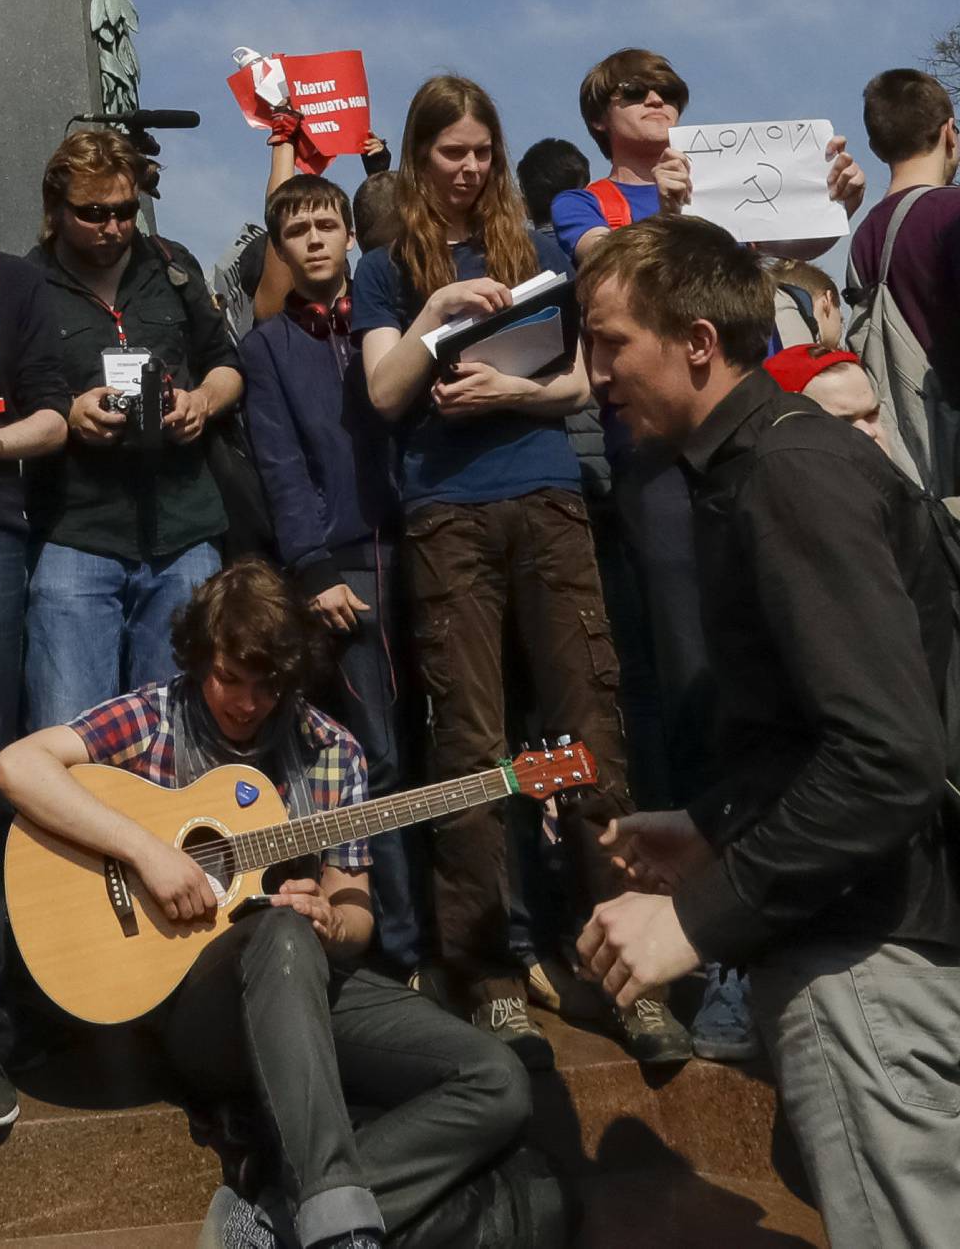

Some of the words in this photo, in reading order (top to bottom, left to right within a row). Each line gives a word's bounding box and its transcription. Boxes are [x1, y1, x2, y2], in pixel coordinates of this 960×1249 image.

[293, 80, 336, 96] Хватит
[300, 98, 348, 116] мешать
[308, 121, 340, 134] жить
[683, 123, 821, 162] ДОЛОЙ
